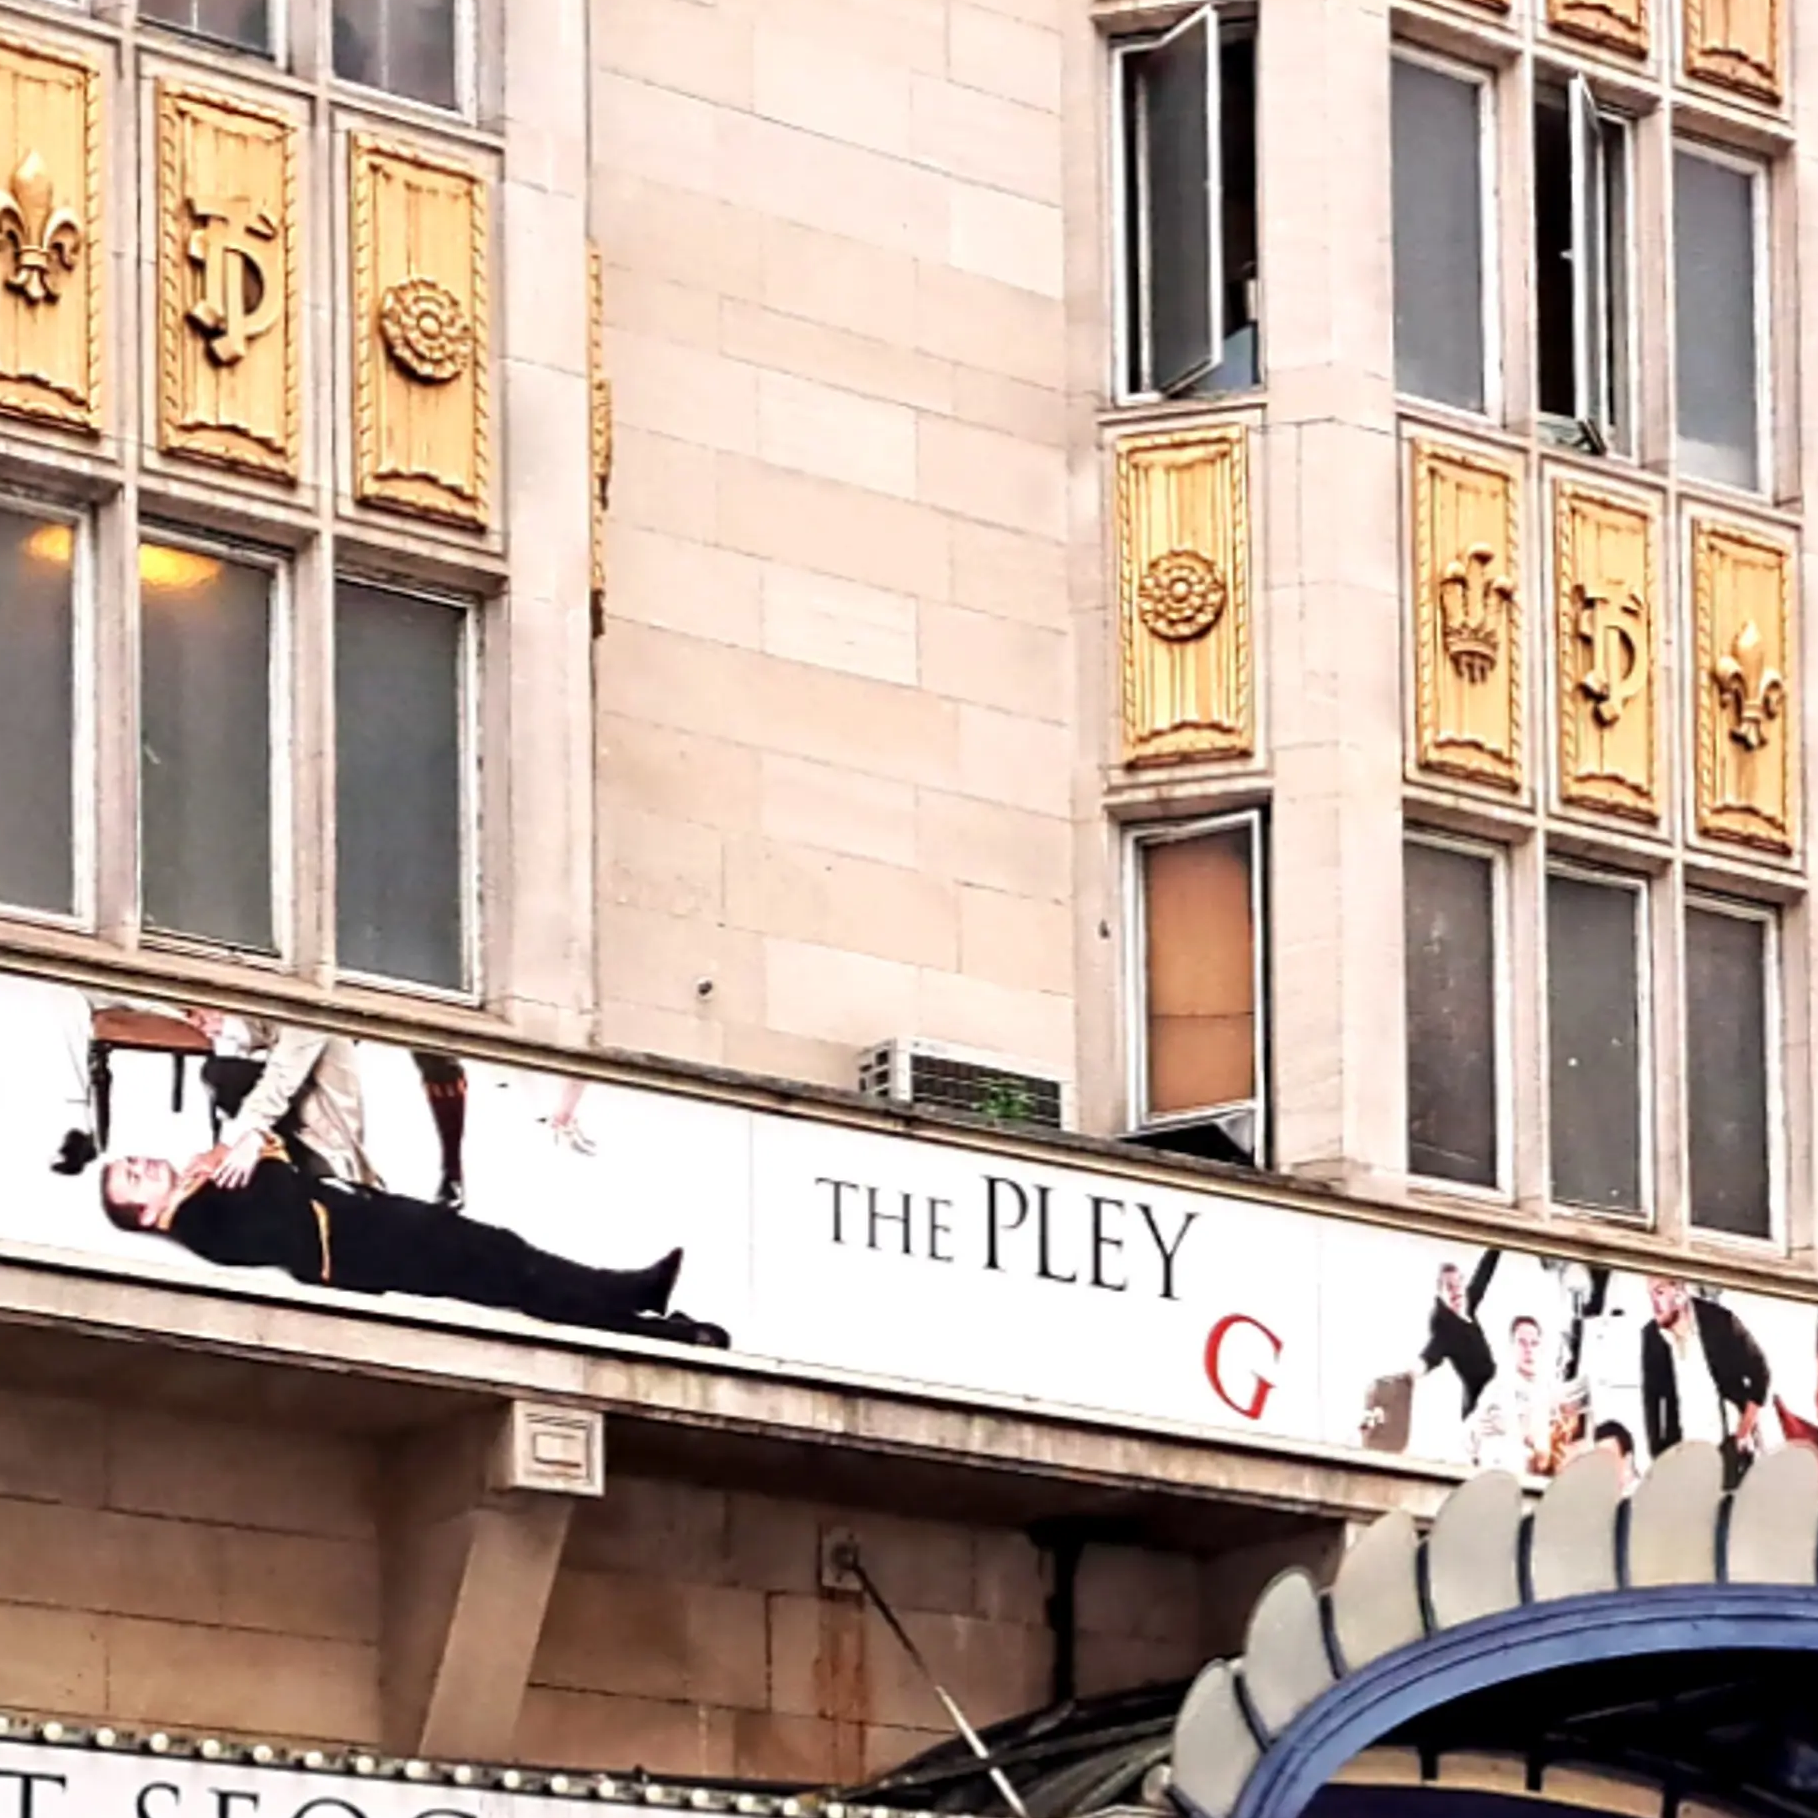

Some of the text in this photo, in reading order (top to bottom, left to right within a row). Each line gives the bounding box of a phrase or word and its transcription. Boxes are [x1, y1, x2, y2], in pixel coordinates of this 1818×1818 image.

[814, 1173, 1204, 1303] THE PLEY
[1202, 1313, 1285, 1421] G
